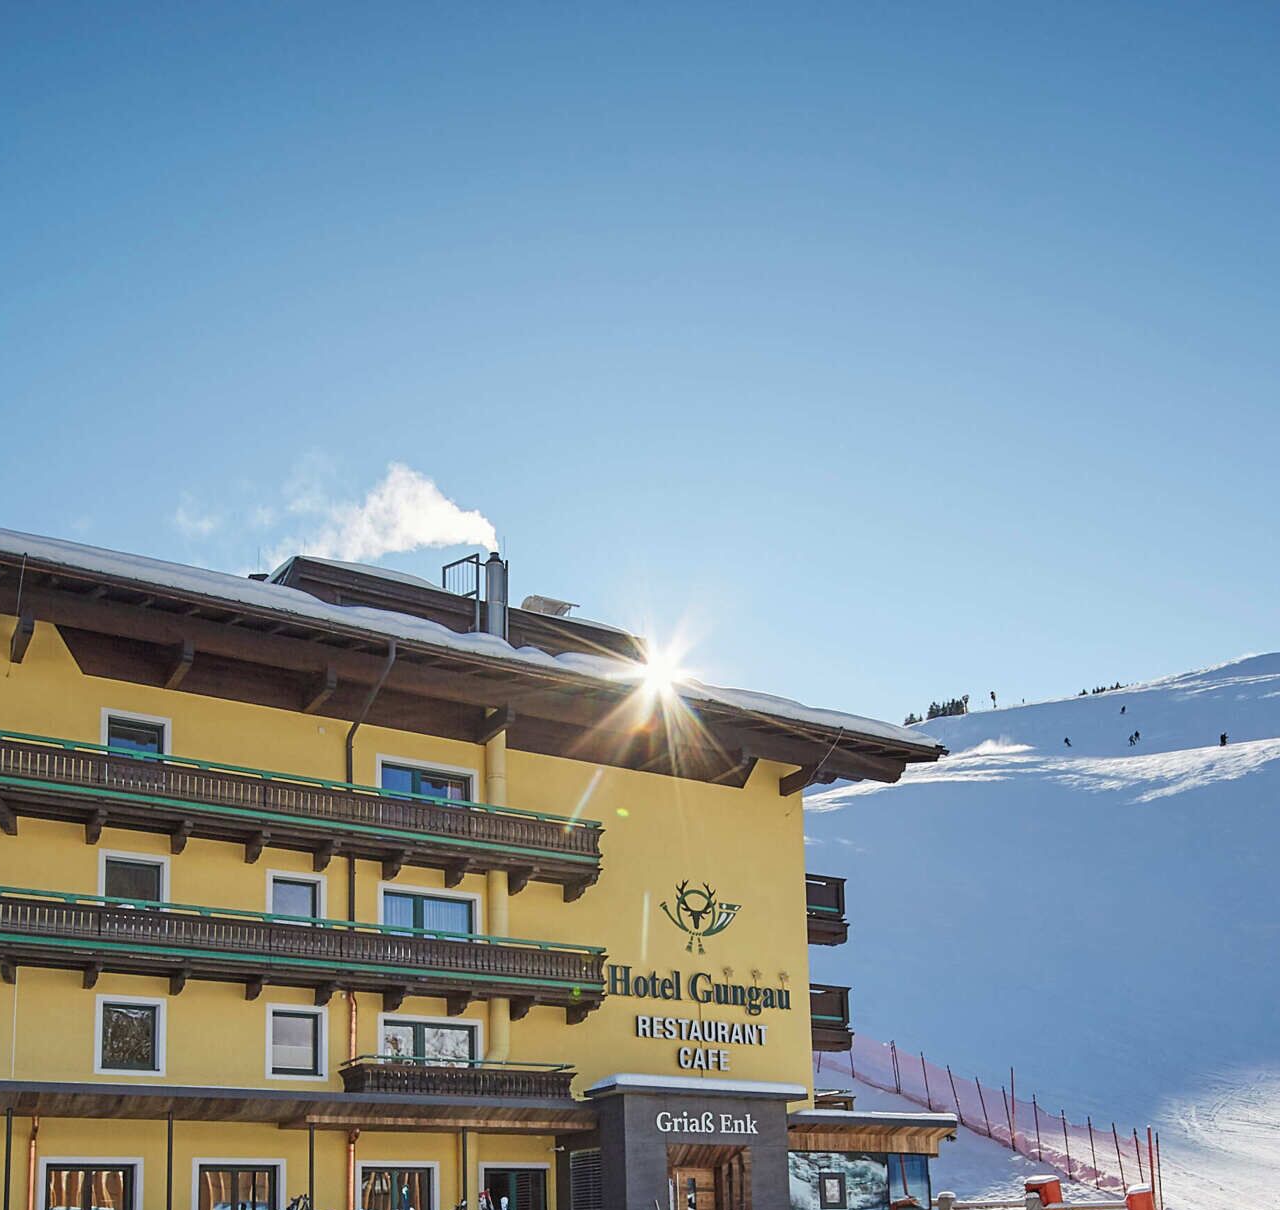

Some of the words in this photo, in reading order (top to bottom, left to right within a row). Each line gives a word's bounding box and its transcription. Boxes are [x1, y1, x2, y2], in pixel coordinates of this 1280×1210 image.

[608, 964, 681, 1001] Hotel
[688, 972, 791, 1016] Gungau
[637, 1015, 768, 1046] RESTAURANT
[679, 1047, 731, 1071] CAFE
[656, 1111, 715, 1133] Griaß
[719, 1114, 759, 1135] Enk
